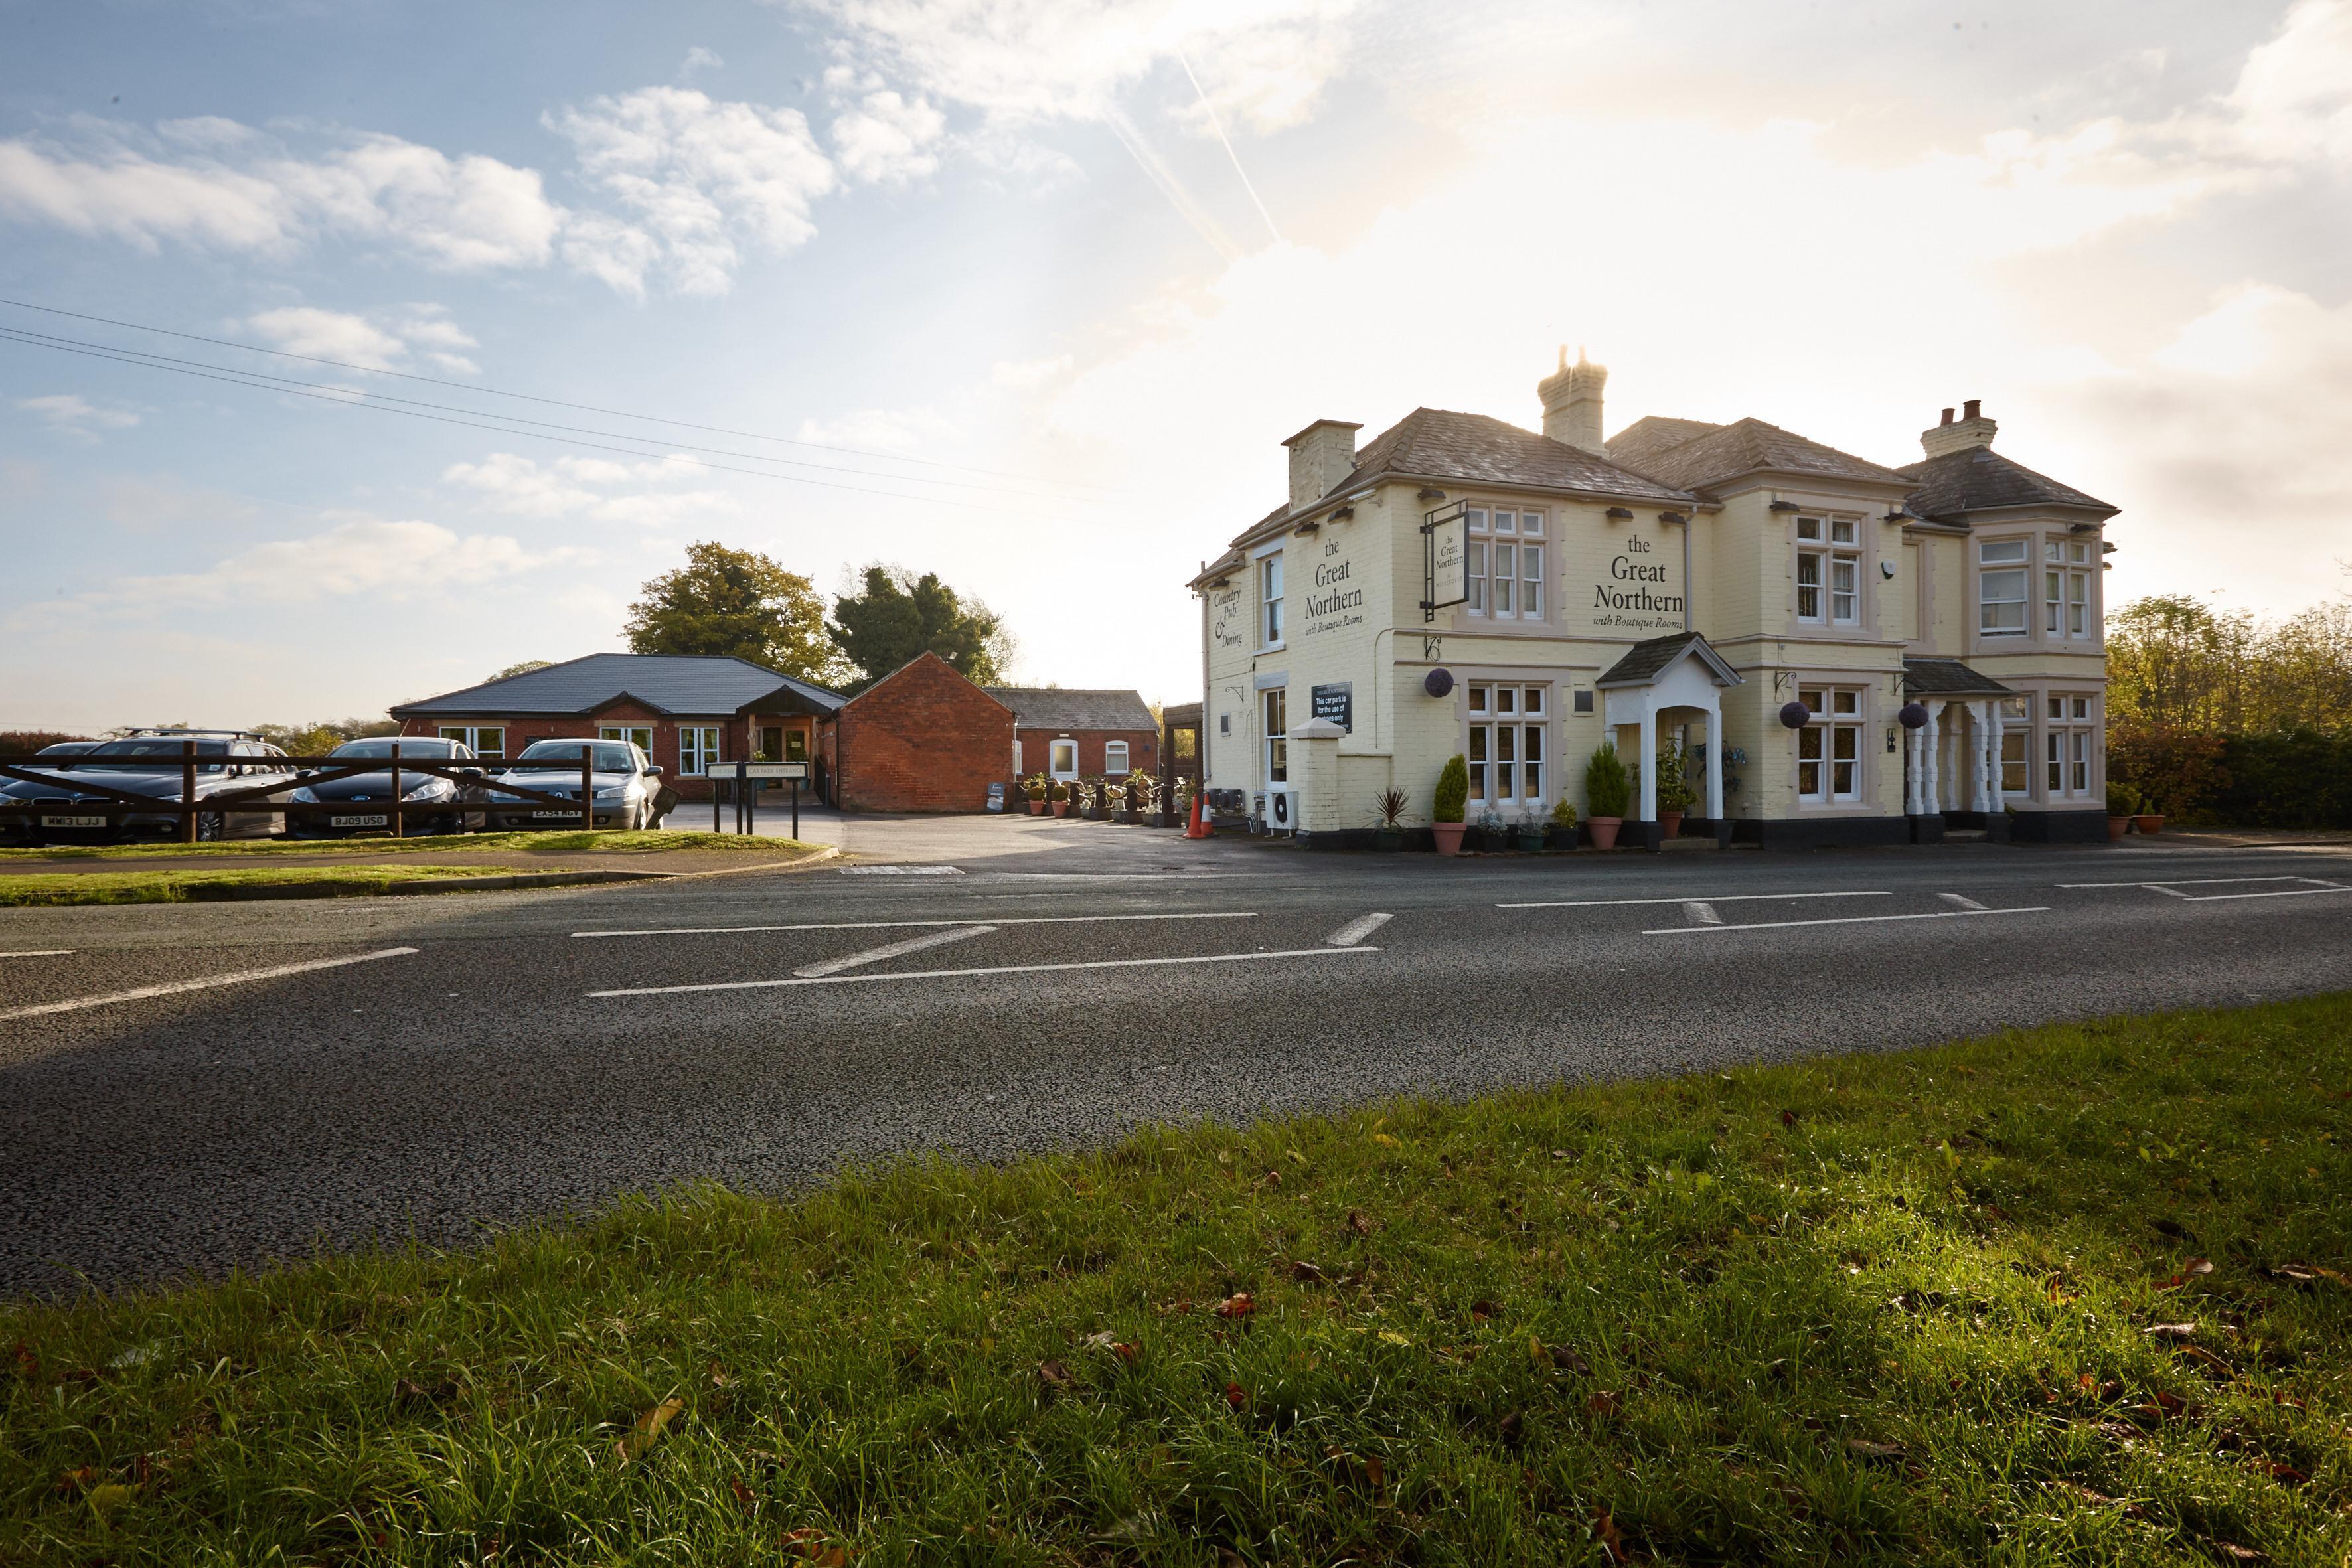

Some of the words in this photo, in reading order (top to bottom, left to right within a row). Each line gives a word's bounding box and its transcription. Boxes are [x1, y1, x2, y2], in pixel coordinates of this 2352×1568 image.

[1325, 538, 1340, 557] the
[1441, 545, 1458, 557] Great
[1628, 534, 1650, 553] the
[1436, 556, 1464, 570] Northern
[1611, 556, 1666, 582] Great
[1316, 558, 1350, 588] Great
[1214, 589, 1241, 607] Country
[1305, 588, 1362, 619] Northern
[1593, 584, 1684, 612] Northern
[1224, 602, 1237, 620] Pub
[1215, 615, 1226, 639] &
[1305, 623, 1317, 636] with
[1318, 619, 1342, 633] Boutique
[1343, 614, 1362, 627] Rooms
[1593, 614, 1612, 626] with
[1614, 615, 1654, 631] Boutique
[1655, 617, 1683, 629] Rooms
[1222, 632, 1243, 647] Dining
[1332, 696, 1342, 705] park
[1334, 714, 1344, 722] only
[48, 817, 73, 826] MW13
[76, 817, 99, 826] LJJ
[335, 817, 361, 826] BJ09
[363, 817, 383, 825] USO
